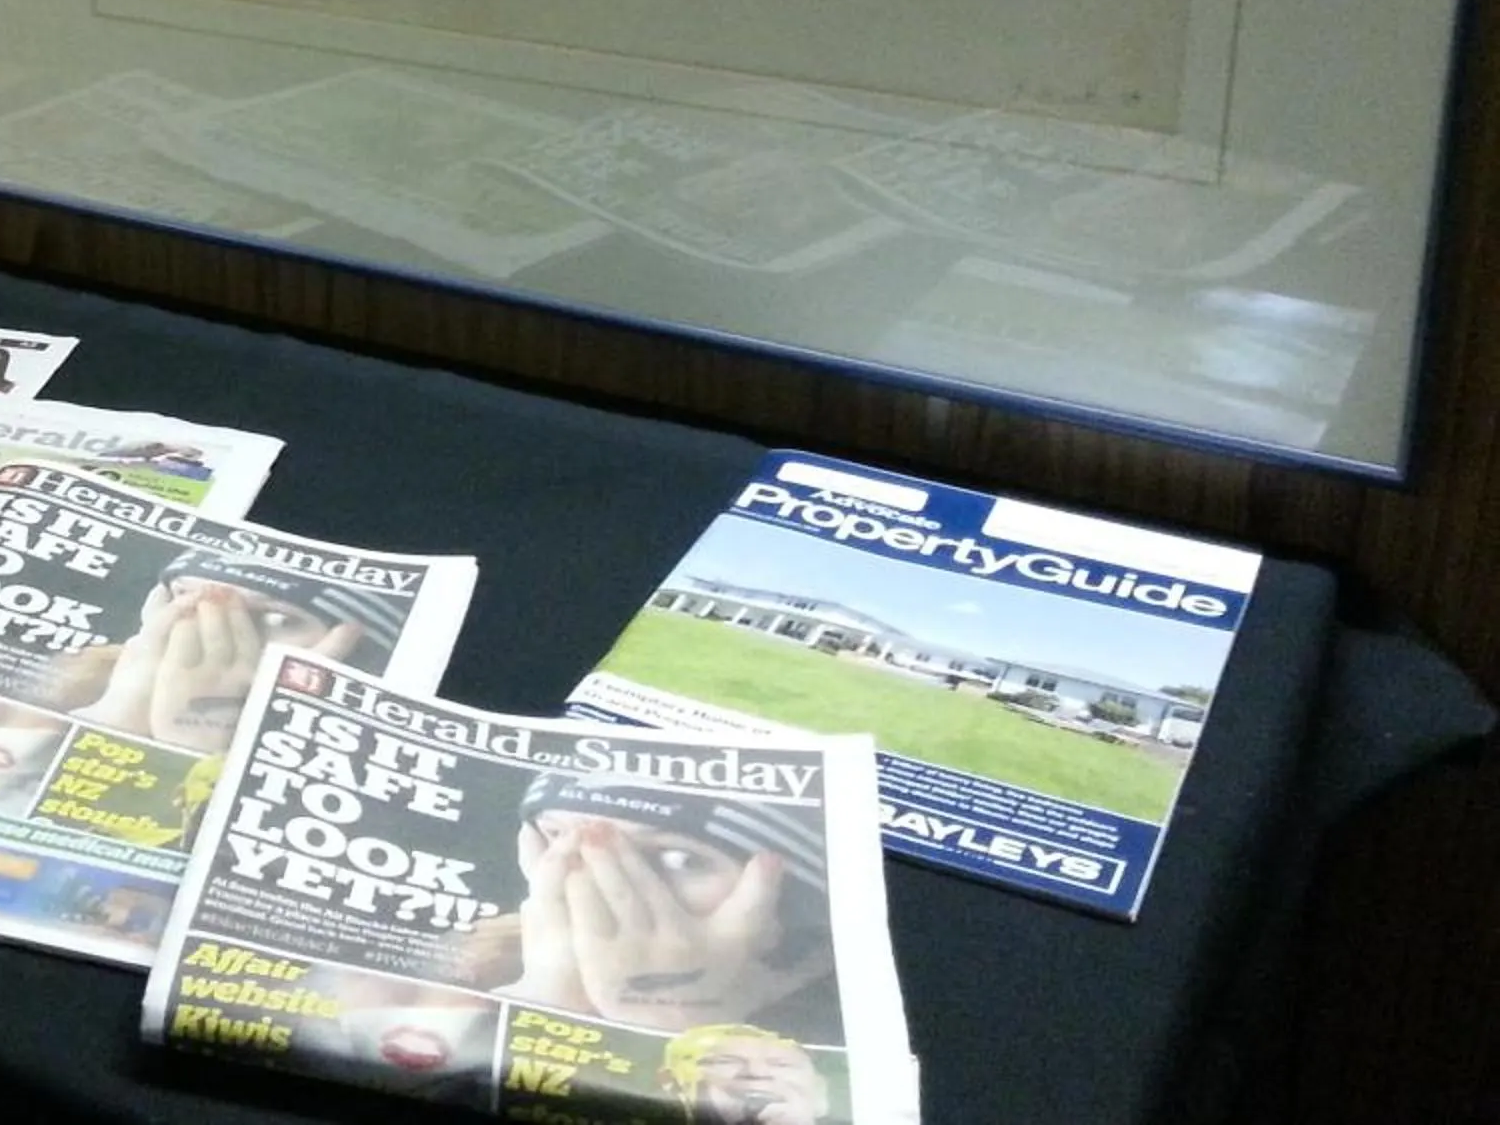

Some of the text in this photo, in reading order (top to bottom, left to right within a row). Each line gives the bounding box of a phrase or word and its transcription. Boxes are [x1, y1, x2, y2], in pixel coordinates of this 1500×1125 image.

[26, 470, 195, 537] Herald
[191, 531, 224, 548] on
[224, 530, 421, 590] Sunday
[46, 509, 126, 548] IT
[809, 489, 942, 531] Advocate
[74, 732, 145, 765] Pop
[325, 671, 820, 798] Herald on Sunday
[63, 756, 158, 789] star's
[254, 731, 464, 822] SAFE
[368, 731, 457, 782] IT
[50, 774, 111, 801] NZ
[250, 761, 363, 824] TO
[590, 792, 673, 817] BLACKS
[31, 823, 132, 865] medical
[230, 796, 475, 895] LOOK
[184, 942, 310, 982] Affair
[180, 975, 340, 1019] website
[172, 1004, 294, 1052] Kiwis
[511, 1010, 602, 1044] Pop
[509, 1036, 633, 1073] star's
[505, 1056, 577, 1096] NZ
